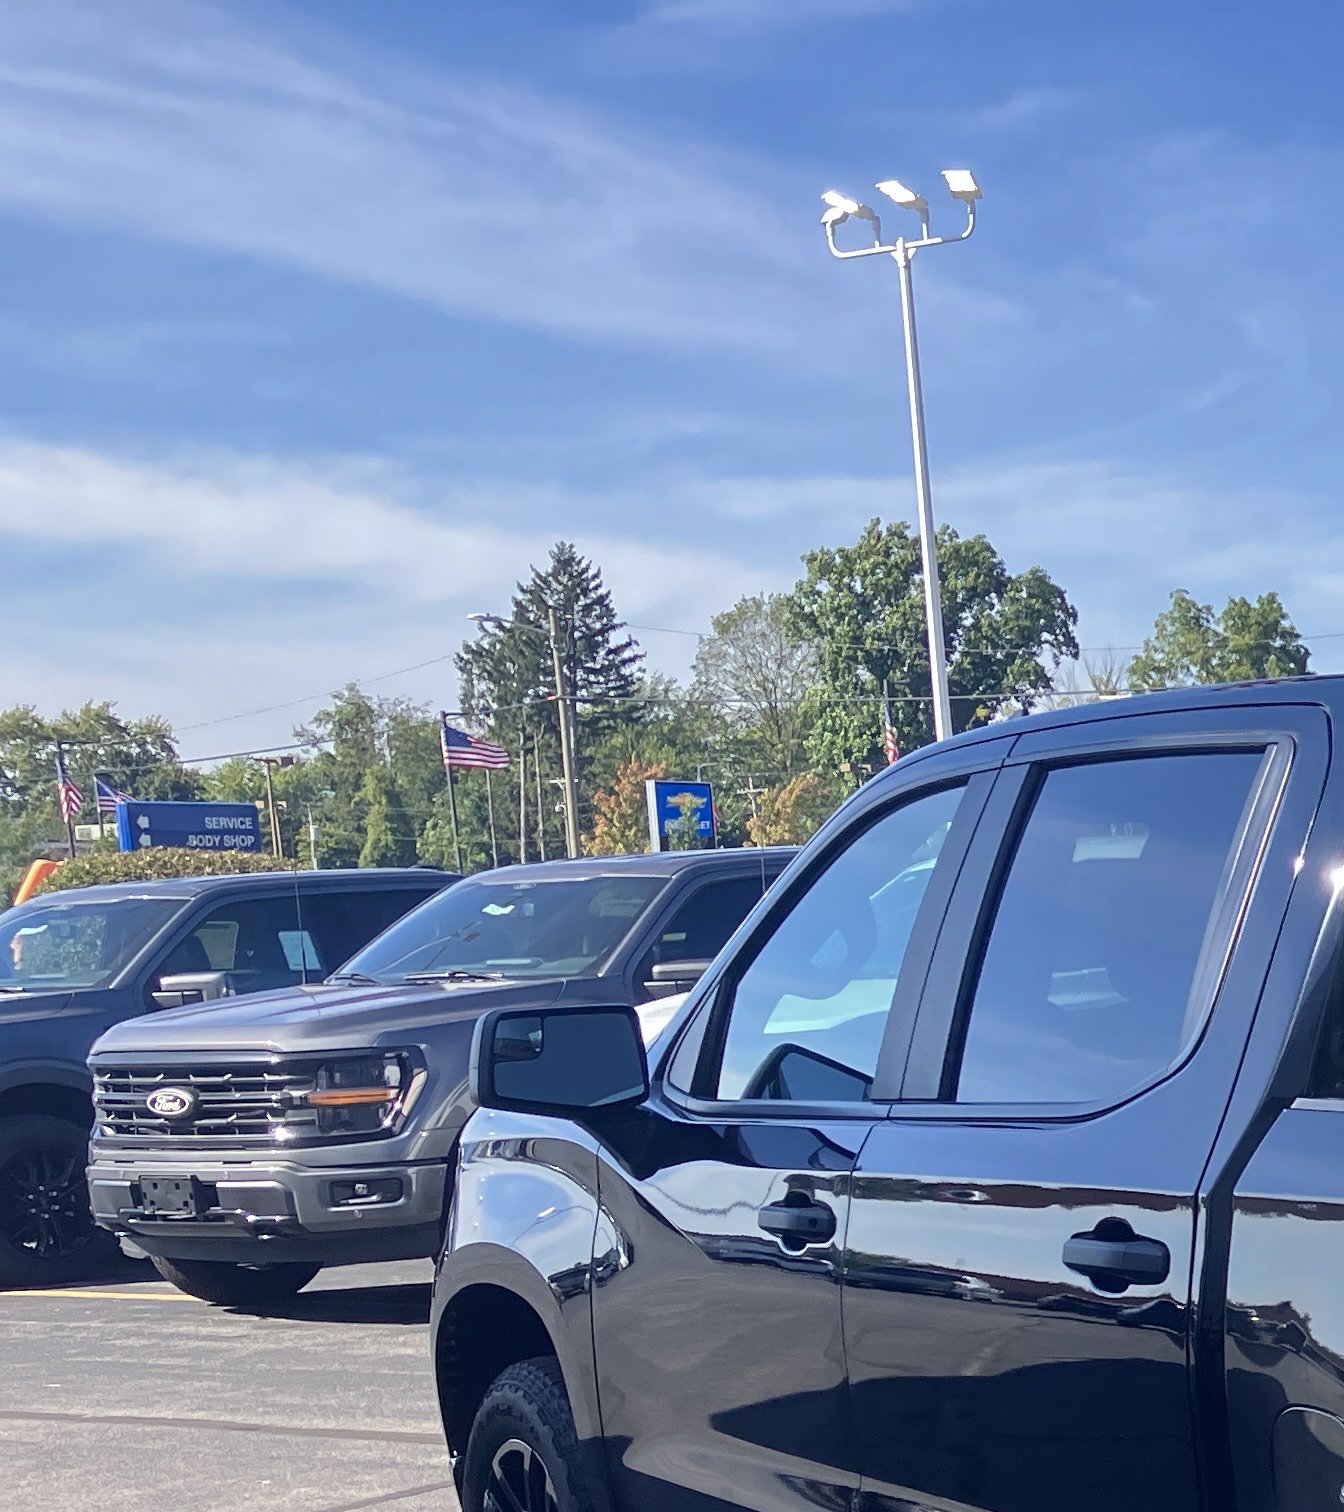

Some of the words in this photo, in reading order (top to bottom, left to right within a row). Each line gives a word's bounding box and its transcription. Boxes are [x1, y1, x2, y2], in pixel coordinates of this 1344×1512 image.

[204, 816, 253, 830] SERVICE
[188, 834, 220, 847] BODY
[223, 835, 255, 848] SHOP
